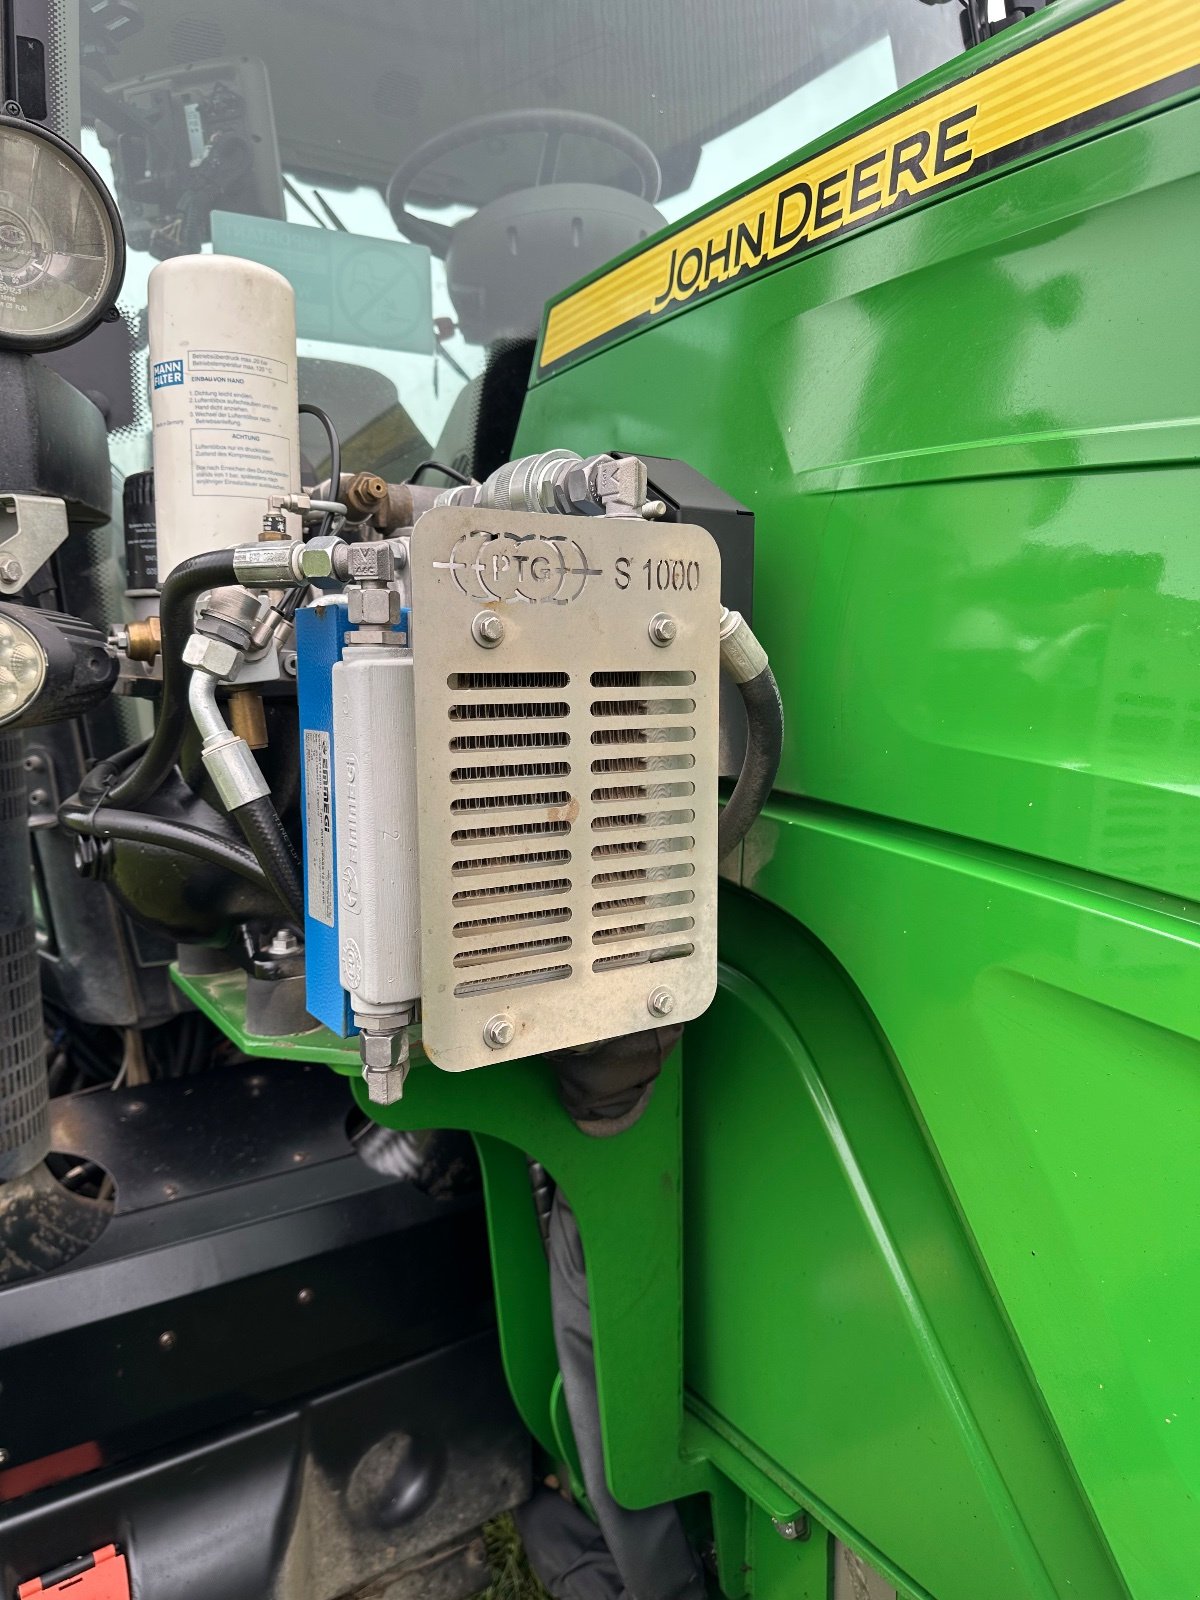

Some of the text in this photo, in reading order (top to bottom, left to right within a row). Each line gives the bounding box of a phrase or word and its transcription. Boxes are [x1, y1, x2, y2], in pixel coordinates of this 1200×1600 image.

[654, 105, 977, 301] JOHN DEERE
[154, 361, 181, 375] MANN
[154, 372, 182, 387] FILTER
[232, 433, 260, 442] ACHTUNG
[492, 554, 551, 582] PTG
[614, 556, 700, 591] S 1000
